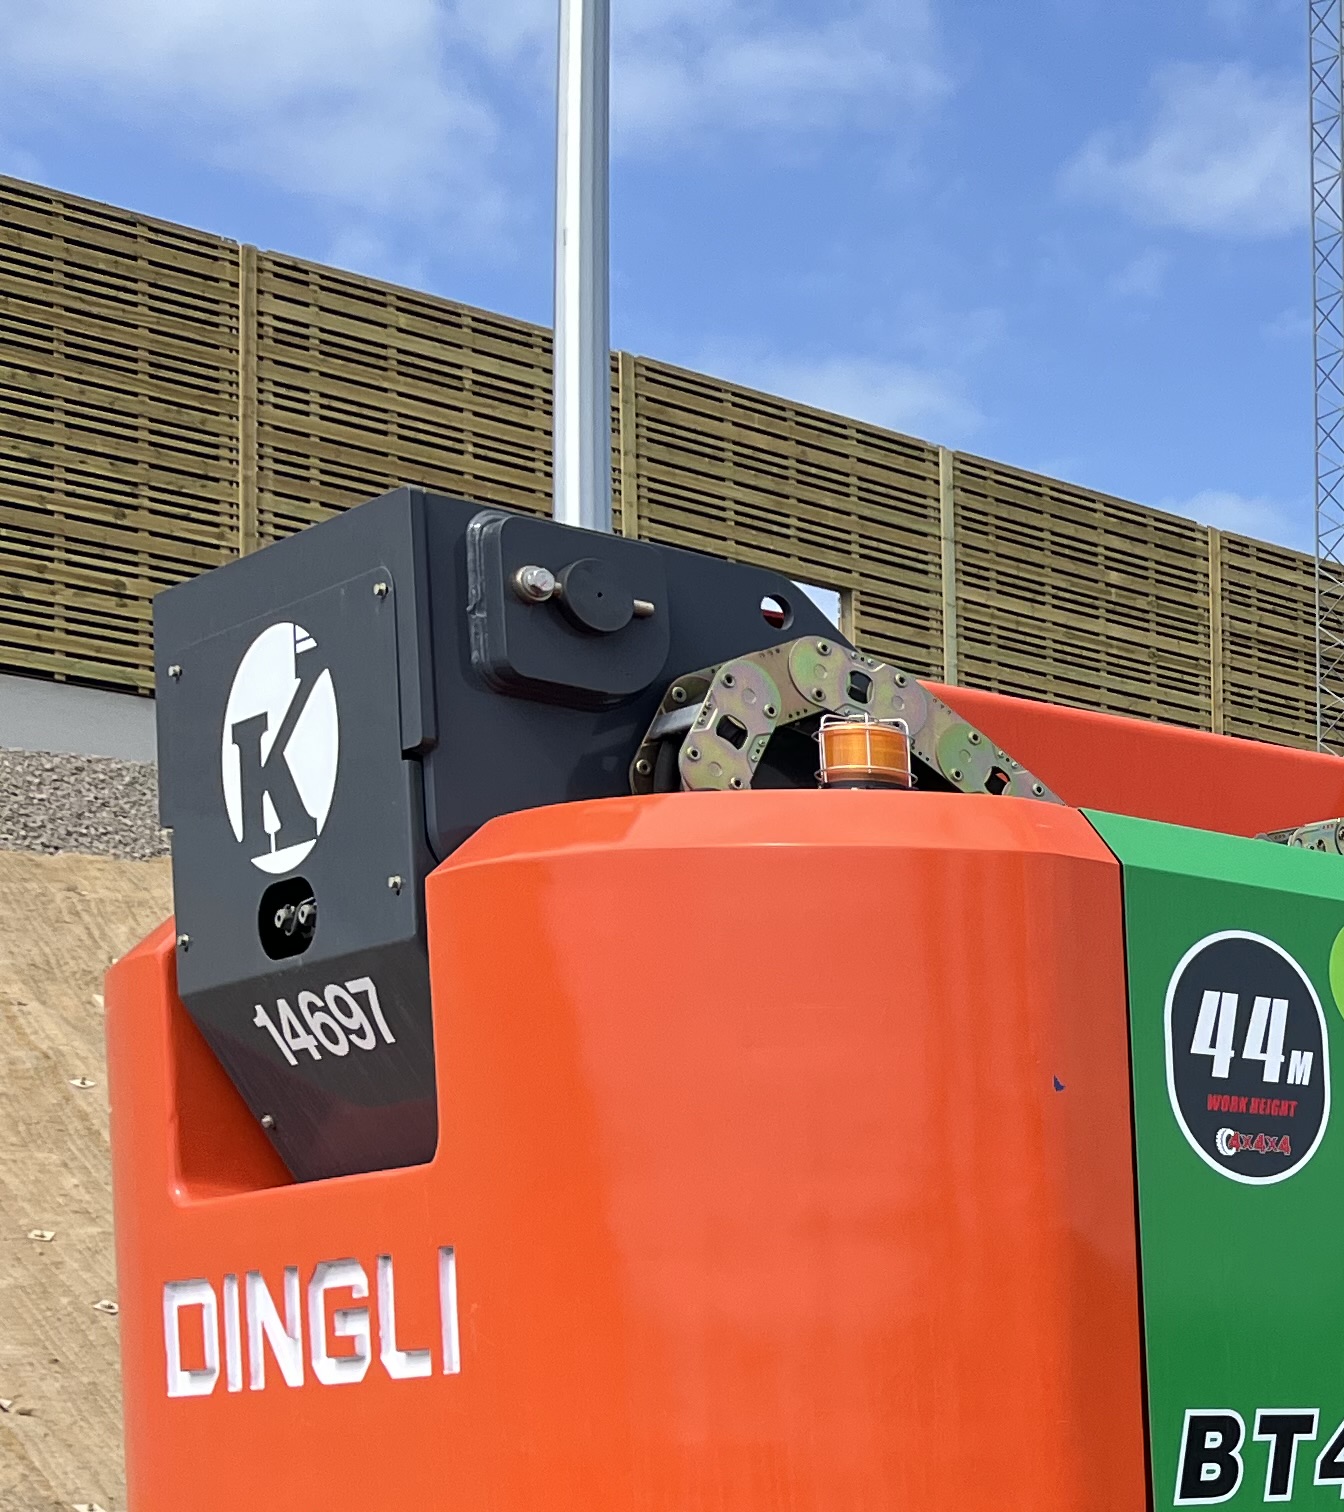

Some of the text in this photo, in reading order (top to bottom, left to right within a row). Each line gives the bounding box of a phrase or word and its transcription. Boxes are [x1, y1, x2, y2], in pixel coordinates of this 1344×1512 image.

[252, 976, 396, 1067] 14697
[1207, 1093, 1298, 1118] WORK HEIGHT
[162, 1245, 461, 1398] DINGLI
